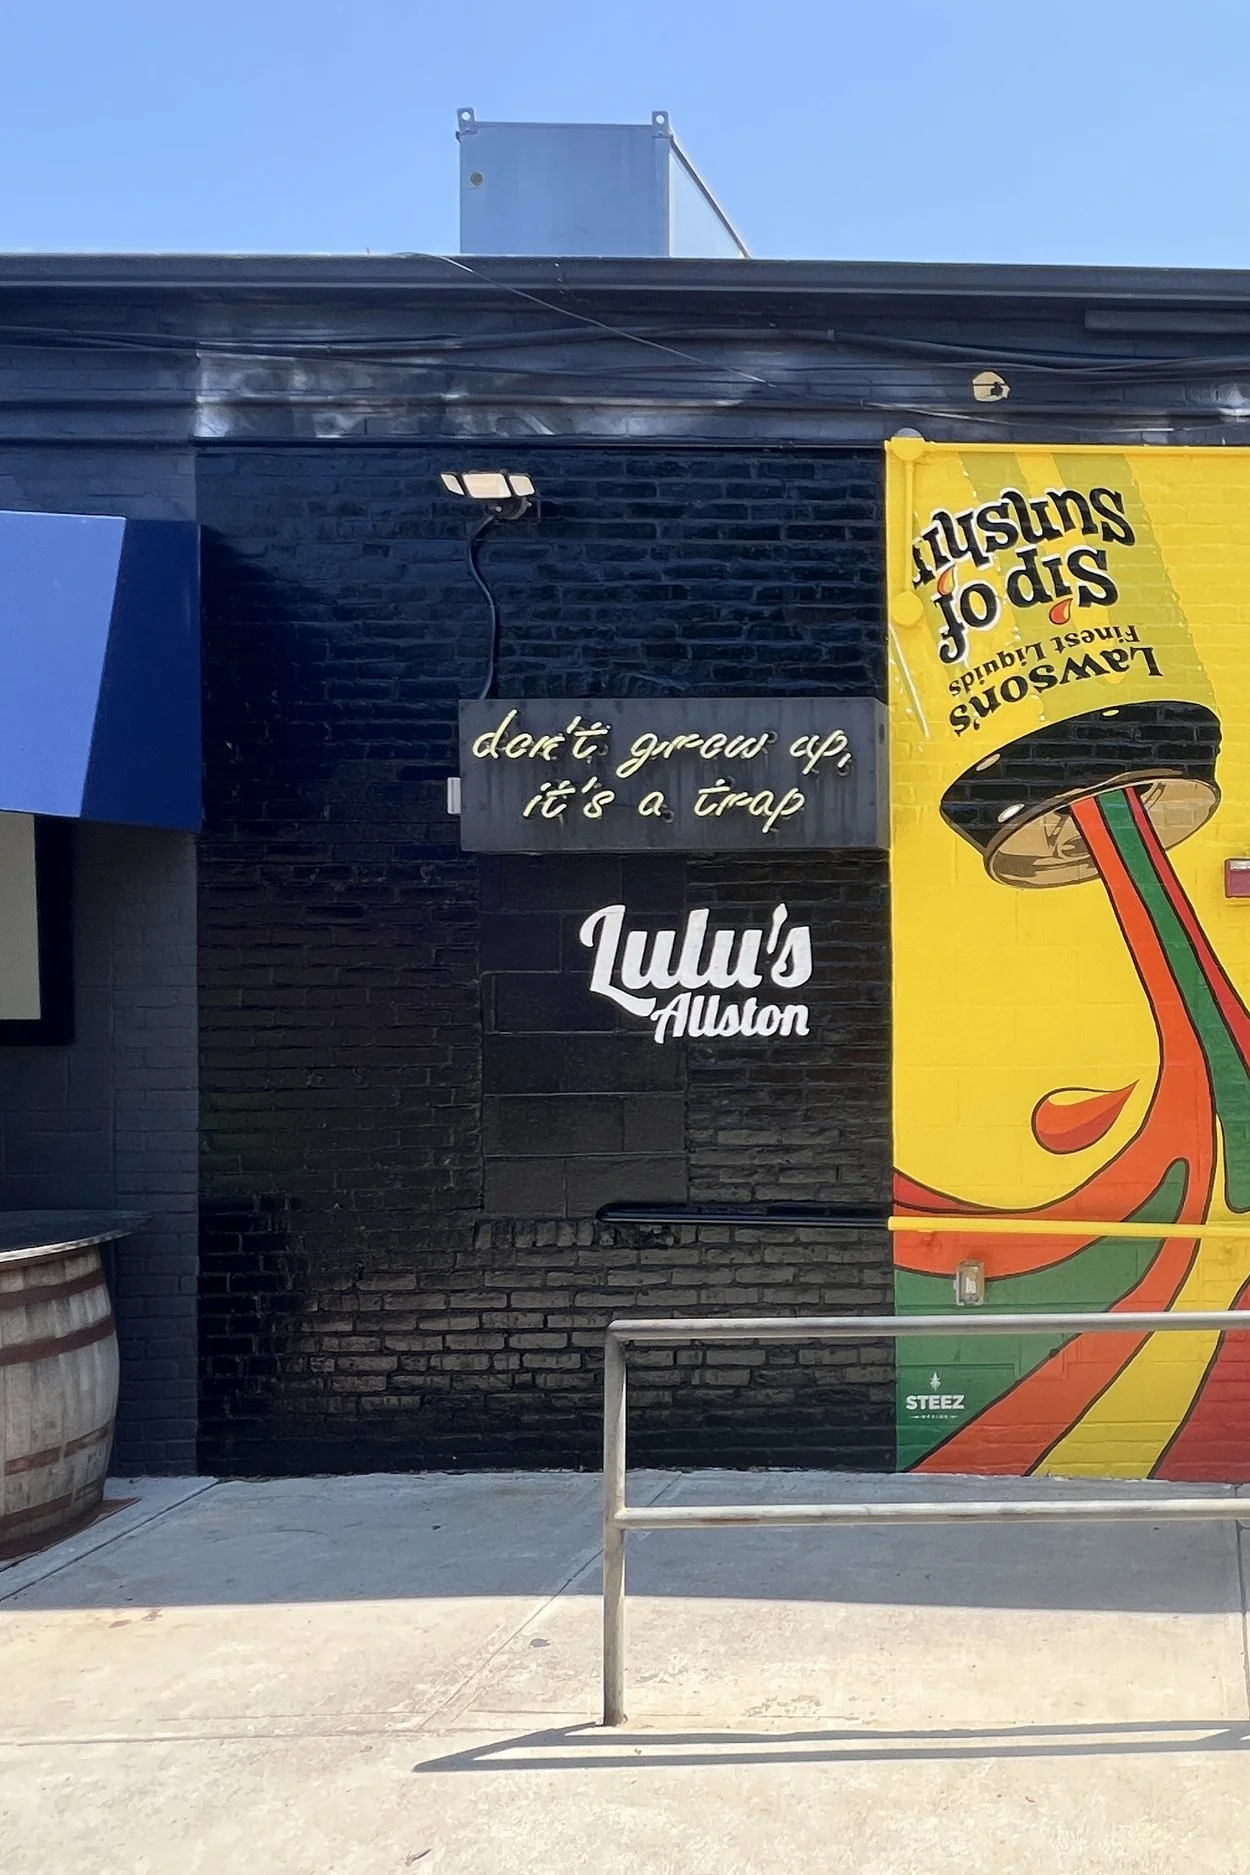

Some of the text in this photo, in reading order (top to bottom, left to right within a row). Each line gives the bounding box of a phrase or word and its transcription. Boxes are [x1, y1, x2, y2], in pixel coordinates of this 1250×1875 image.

[932, 547, 1119, 664] Sip of
[949, 625, 1140, 697] Finest Liquids
[949, 646, 1163, 736] Lawson's
[472, 708, 852, 778] don't grow up,
[523, 776, 806, 833] it's a trap
[579, 902, 813, 1017] Lulu's
[650, 991, 811, 1045] Allston
[906, 1395, 965, 1410] STEEZ
